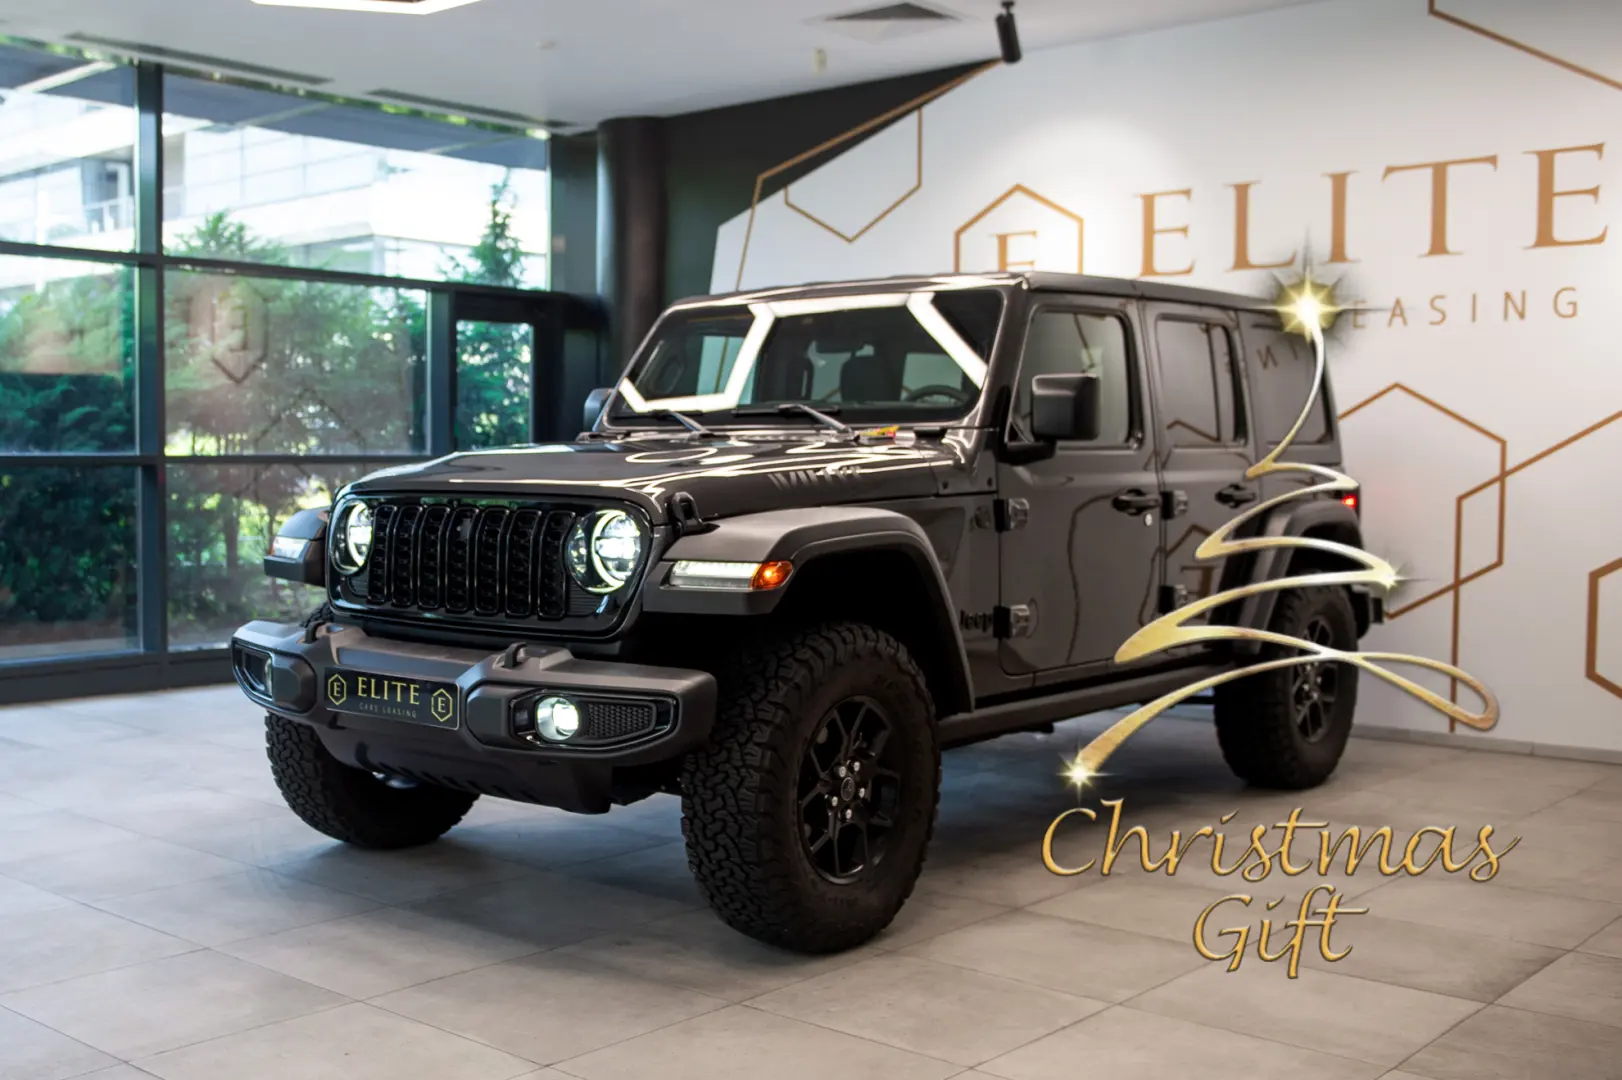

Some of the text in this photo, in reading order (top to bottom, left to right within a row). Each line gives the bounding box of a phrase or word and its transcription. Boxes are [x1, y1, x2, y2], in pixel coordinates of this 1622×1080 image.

[1133, 142, 1609, 278] ELITE
[1352, 286, 1578, 330] EASING
[333, 681, 341, 697] E
[357, 676, 420, 705] ELITE
[437, 697, 446, 713] E
